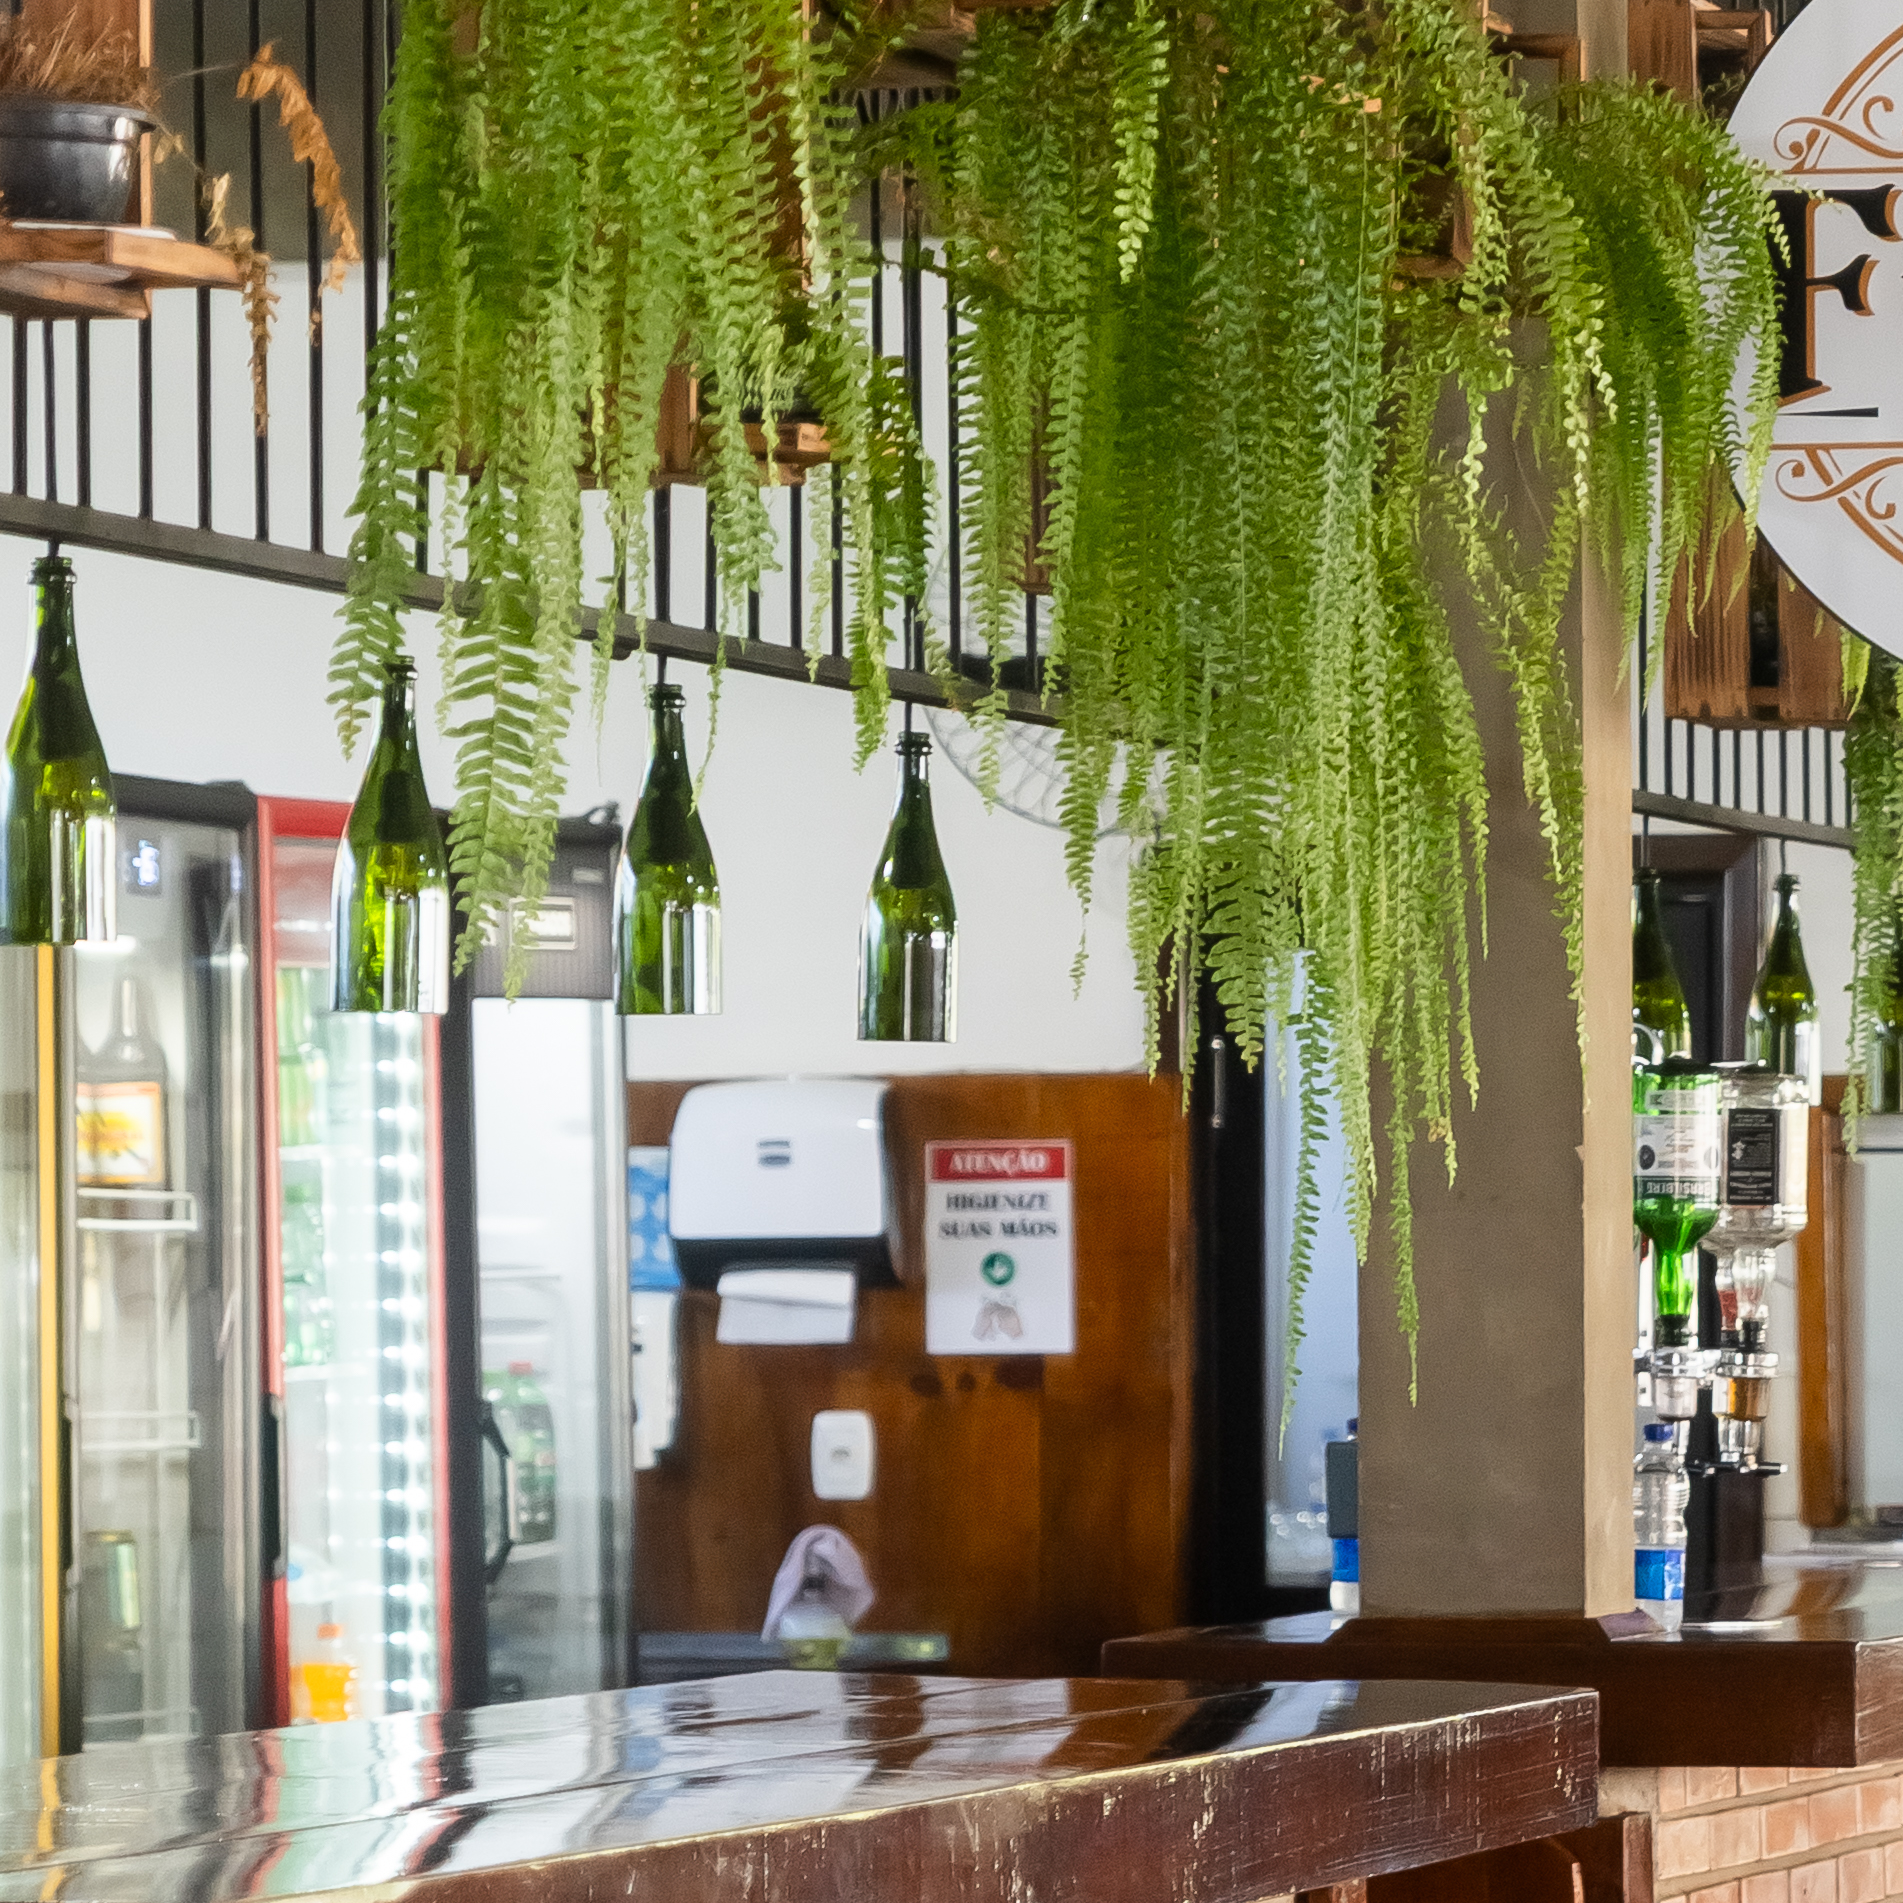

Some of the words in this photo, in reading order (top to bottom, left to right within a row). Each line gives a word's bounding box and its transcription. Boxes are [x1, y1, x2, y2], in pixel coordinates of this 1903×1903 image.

[952, 1149, 1047, 1175] ATENÇÃO
[946, 1192, 1049, 1211] HIGIENIZE
[939, 1219, 993, 1238] SUAS
[1000, 1215, 1059, 1238] MÃOS
